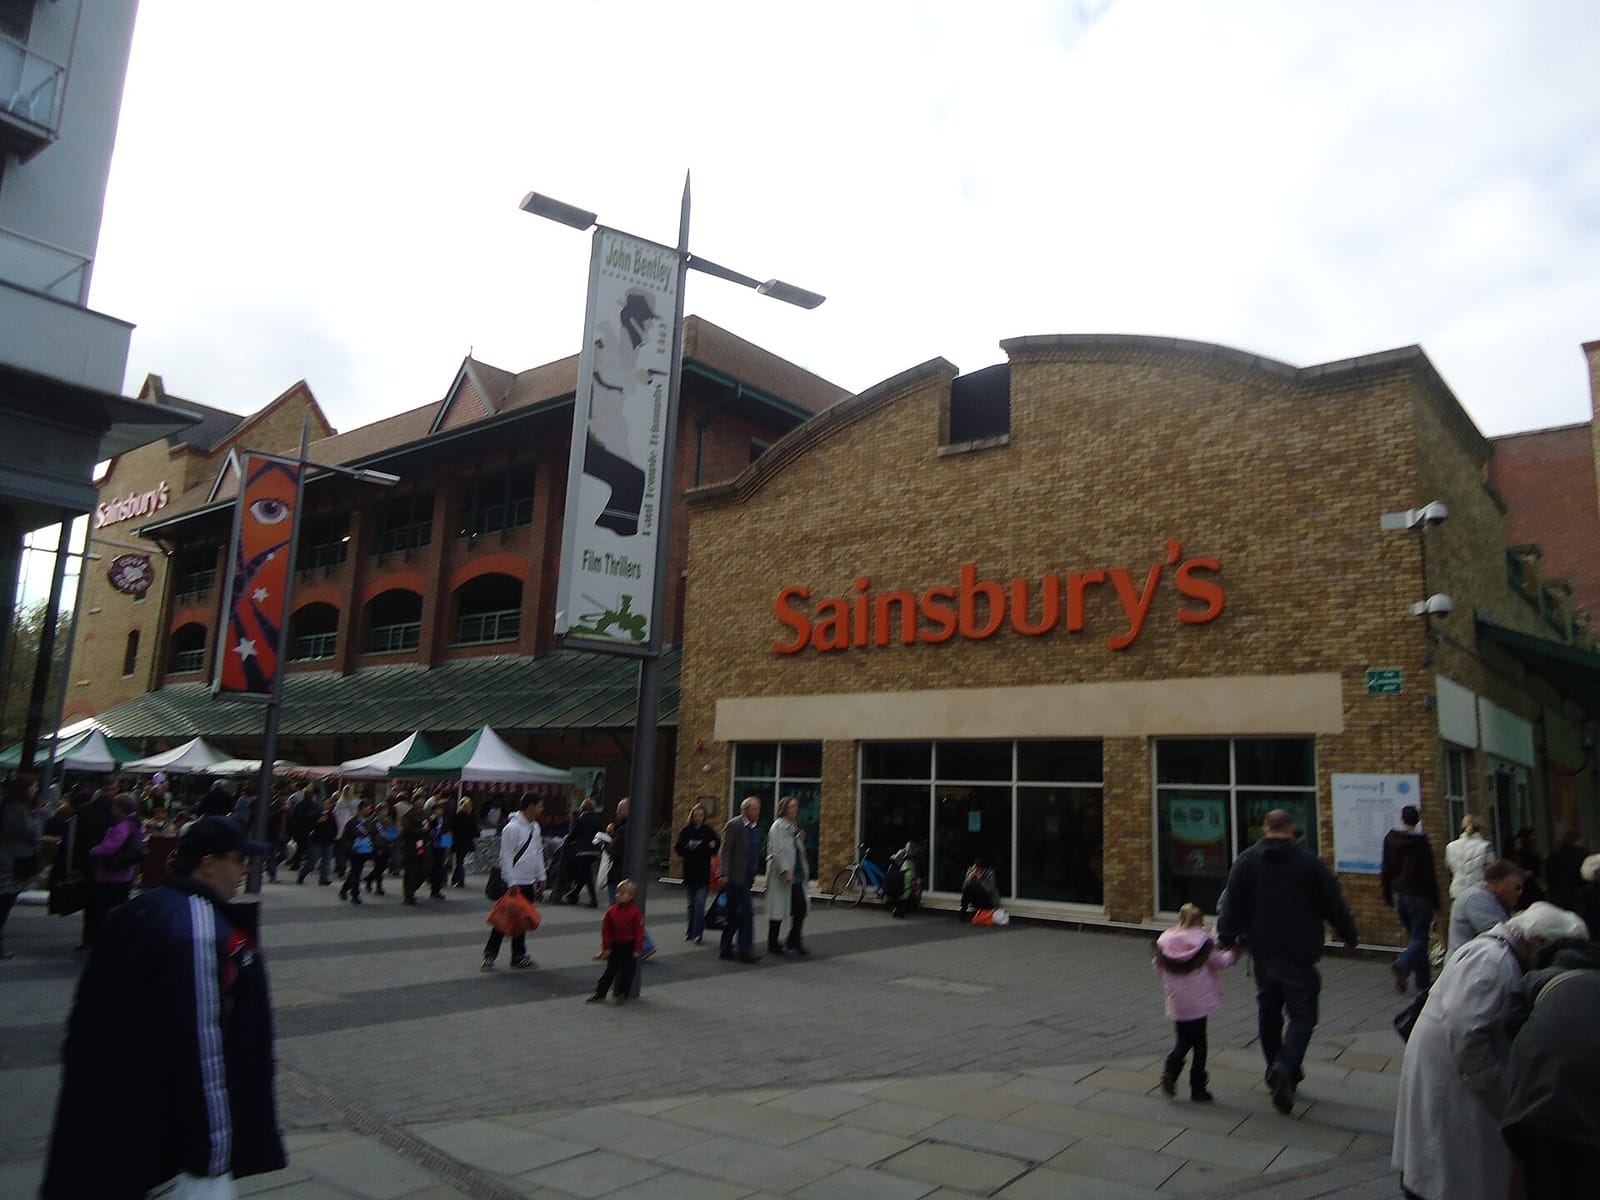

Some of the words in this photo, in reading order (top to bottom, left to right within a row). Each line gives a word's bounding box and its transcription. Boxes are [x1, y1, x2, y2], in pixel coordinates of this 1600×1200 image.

[606, 238, 631, 272] John
[633, 249, 672, 292] Bentley
[94, 480, 169, 529] Sainsbury's
[581, 548, 602, 573] Film
[604, 552, 642, 580] Thrillers
[771, 539, 1226, 654] Sainsbury's
